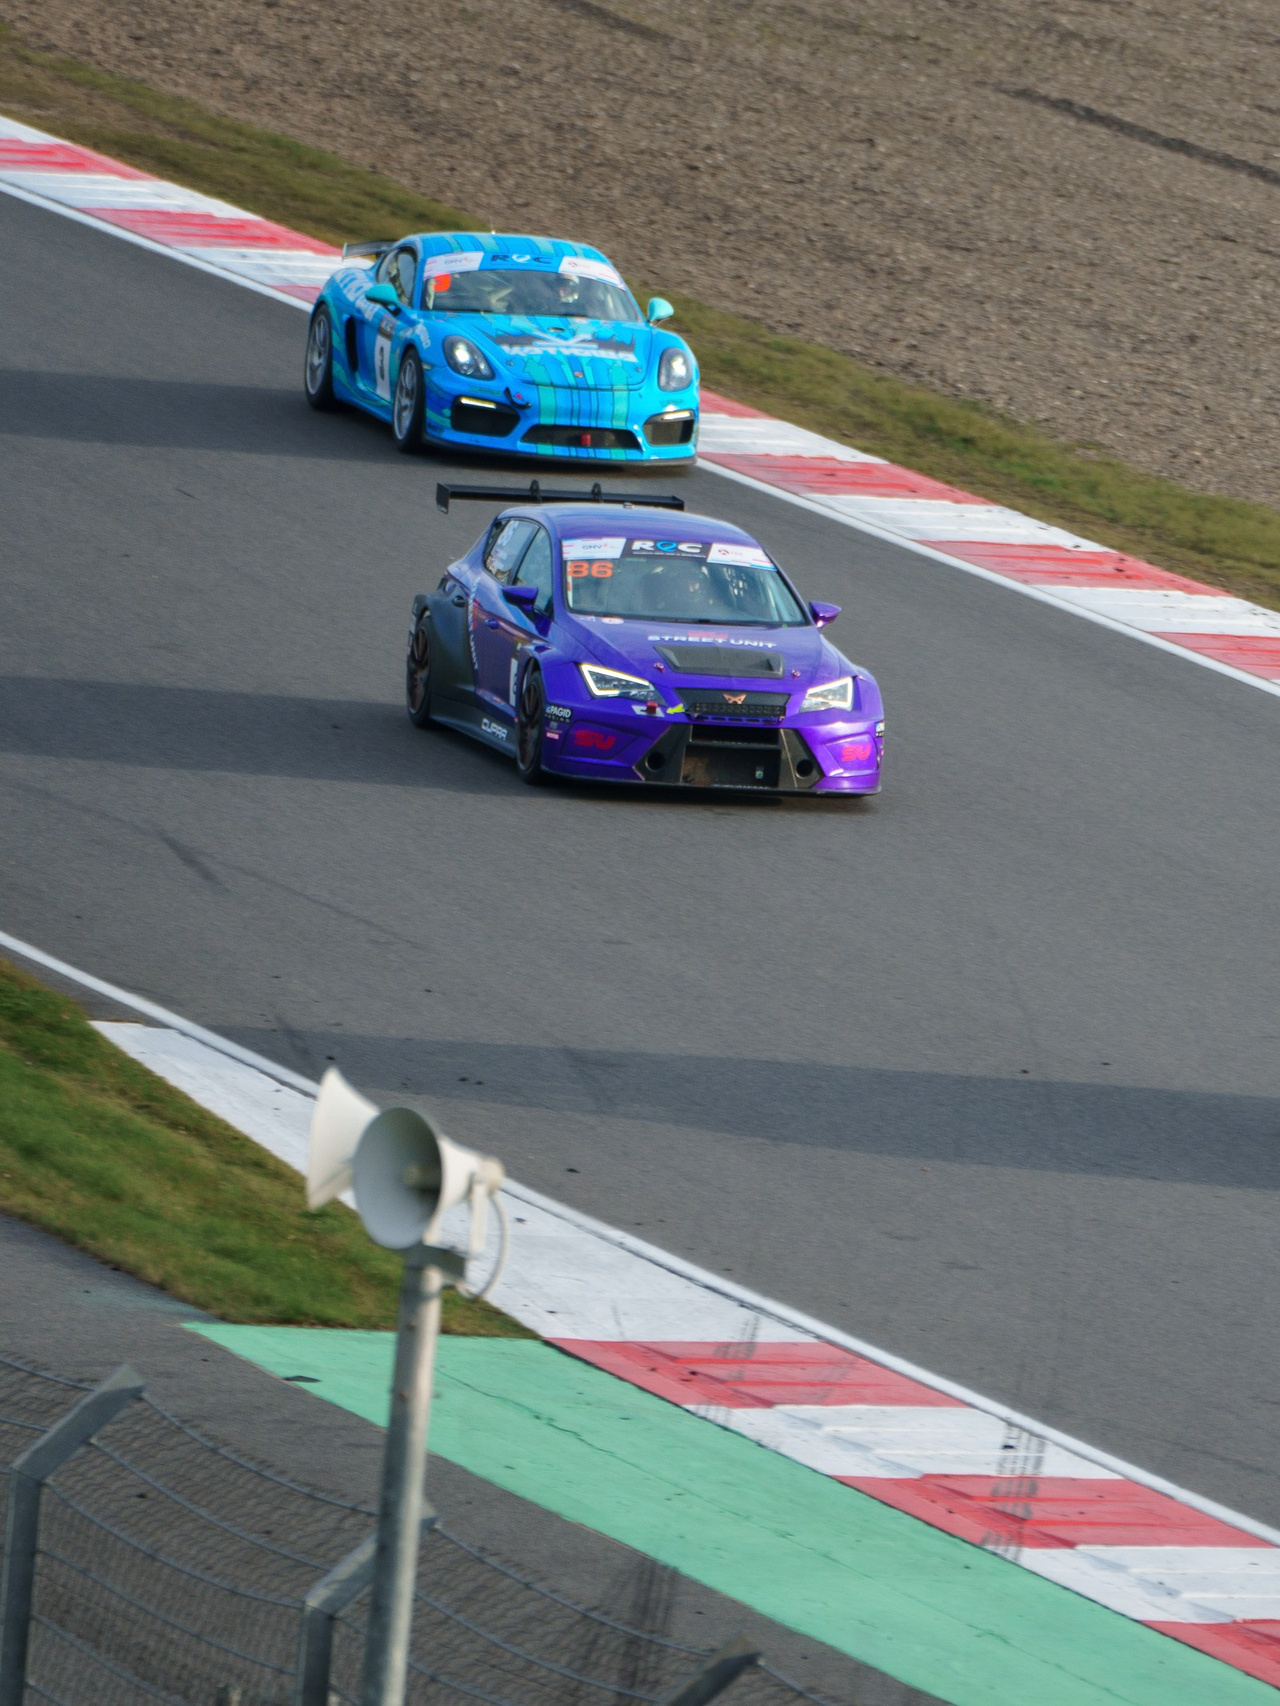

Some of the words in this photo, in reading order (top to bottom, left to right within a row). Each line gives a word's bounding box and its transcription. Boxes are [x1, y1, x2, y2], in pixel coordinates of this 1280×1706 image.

[567, 560, 613, 579] 86
[647, 635, 727, 643] STREET
[729, 638, 778, 648] UNIT
[550, 704, 572, 719] PAGID
[480, 716, 509, 742] CUPRA
